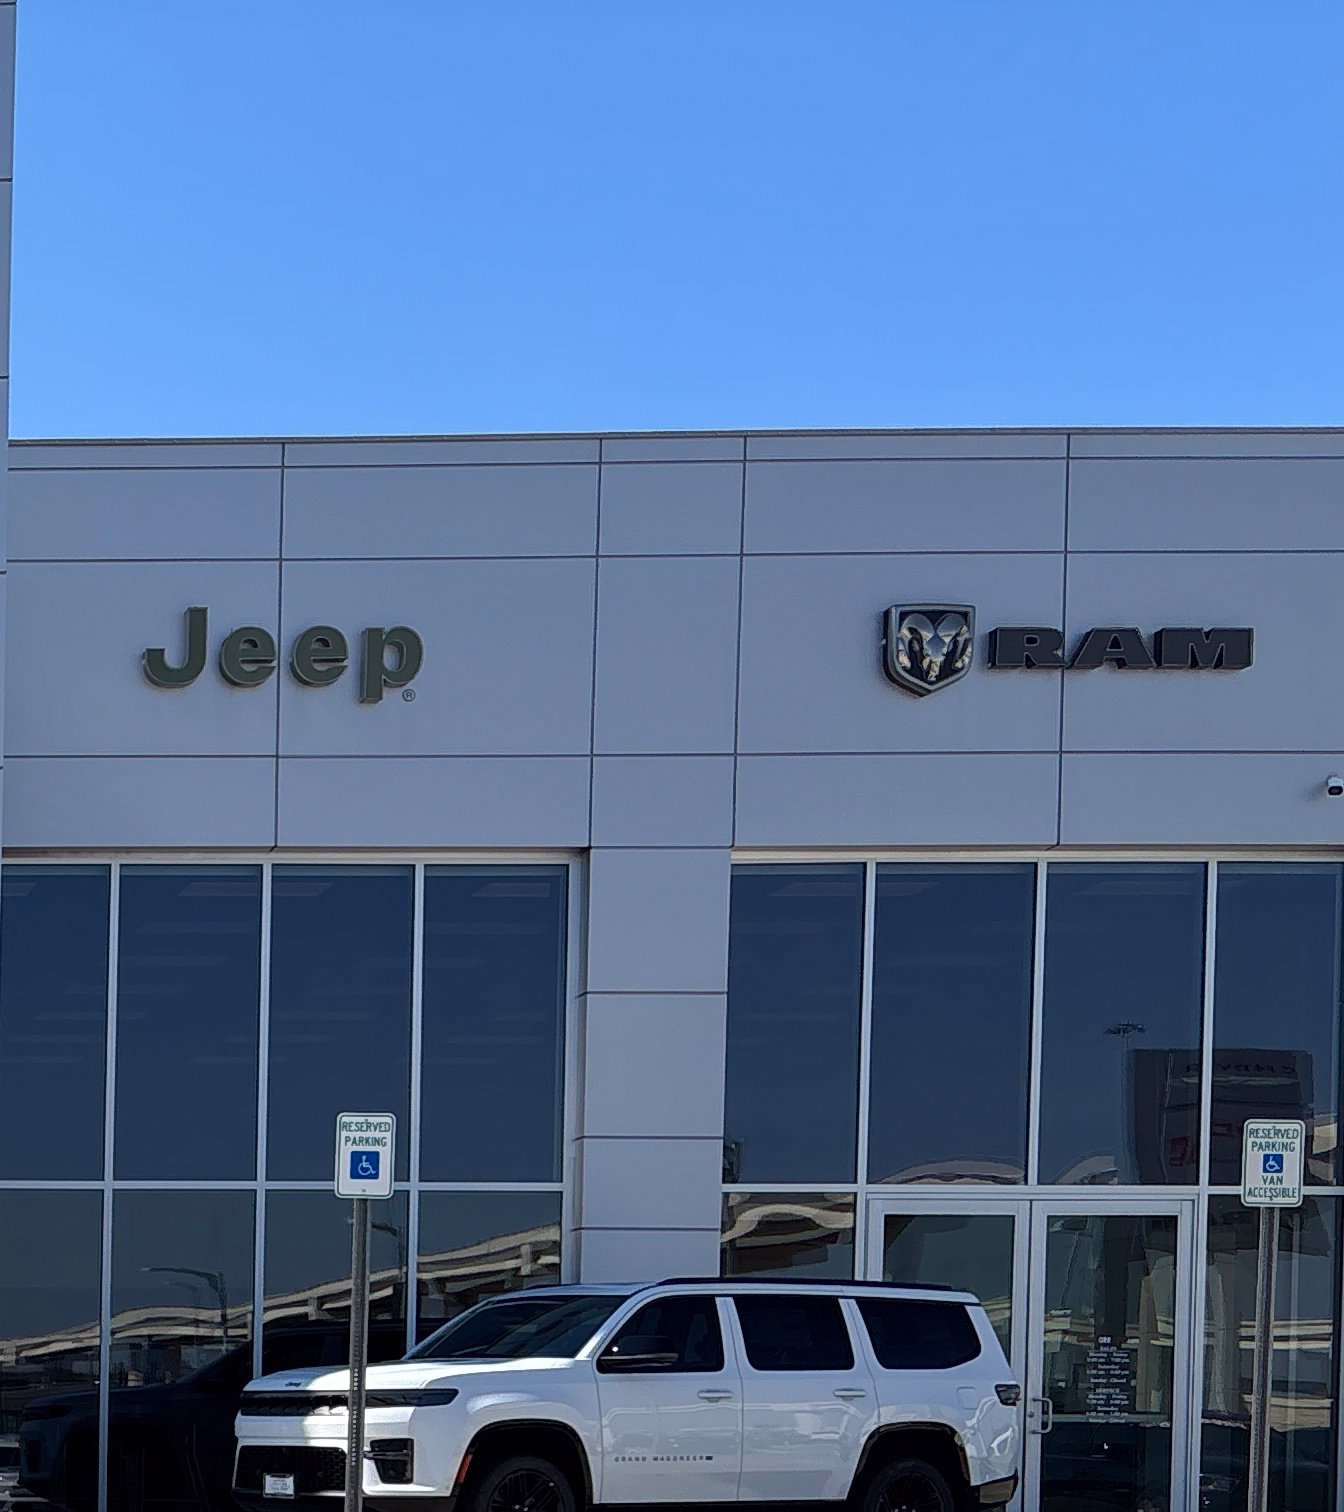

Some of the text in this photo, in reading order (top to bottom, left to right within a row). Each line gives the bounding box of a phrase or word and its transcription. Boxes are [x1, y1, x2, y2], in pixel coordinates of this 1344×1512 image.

[986, 625, 1255, 671] RAM
[142, 606, 424, 703] Jeep
[341, 1121, 391, 1133] RESERVED
[1248, 1128, 1300, 1139] RESERVED
[344, 1136, 388, 1147] PARKING
[1251, 1141, 1296, 1152] PARKING
[1262, 1175, 1284, 1186] VAN
[1247, 1187, 1297, 1198] ACCESSIBLE
